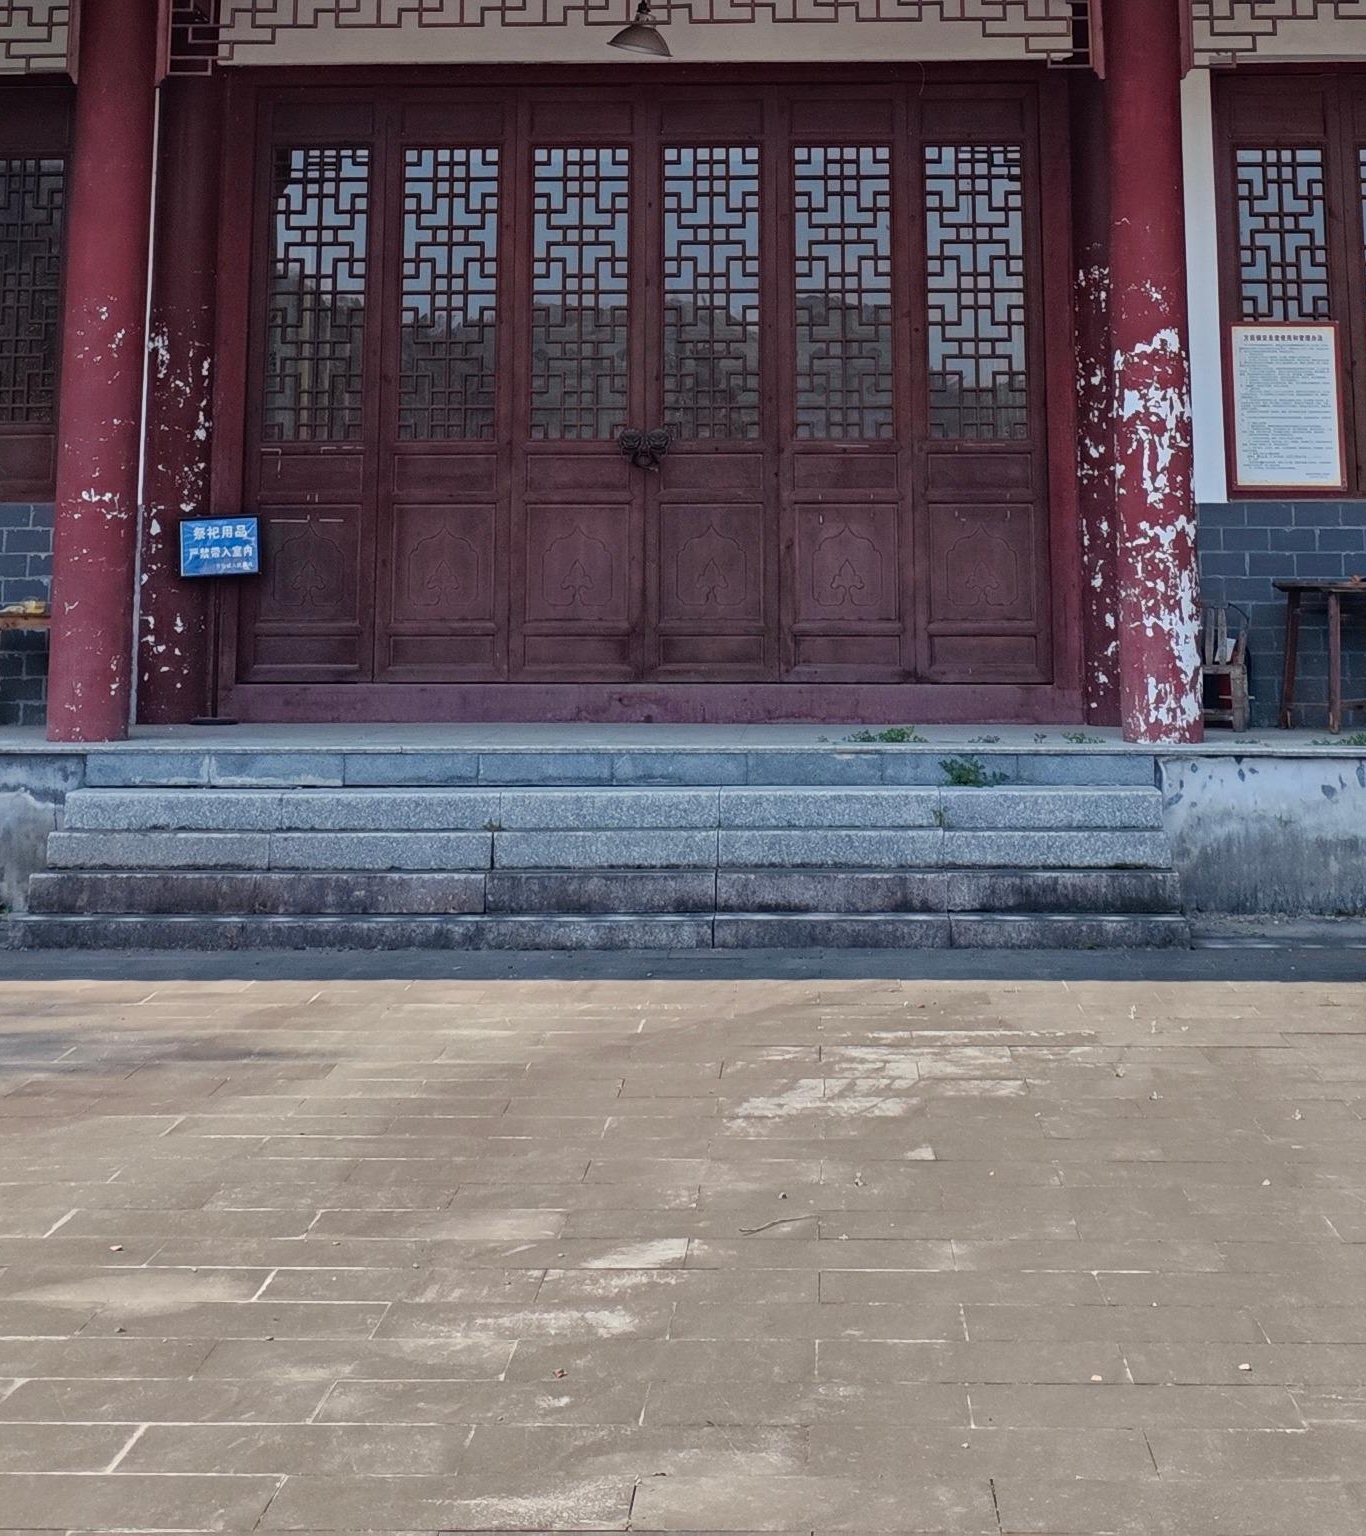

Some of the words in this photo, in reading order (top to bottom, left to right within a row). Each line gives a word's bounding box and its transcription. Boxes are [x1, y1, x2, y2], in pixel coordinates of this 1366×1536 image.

[193, 524, 248, 540] 祭祀用品
[188, 544, 253, 560] 严禁带入室内
